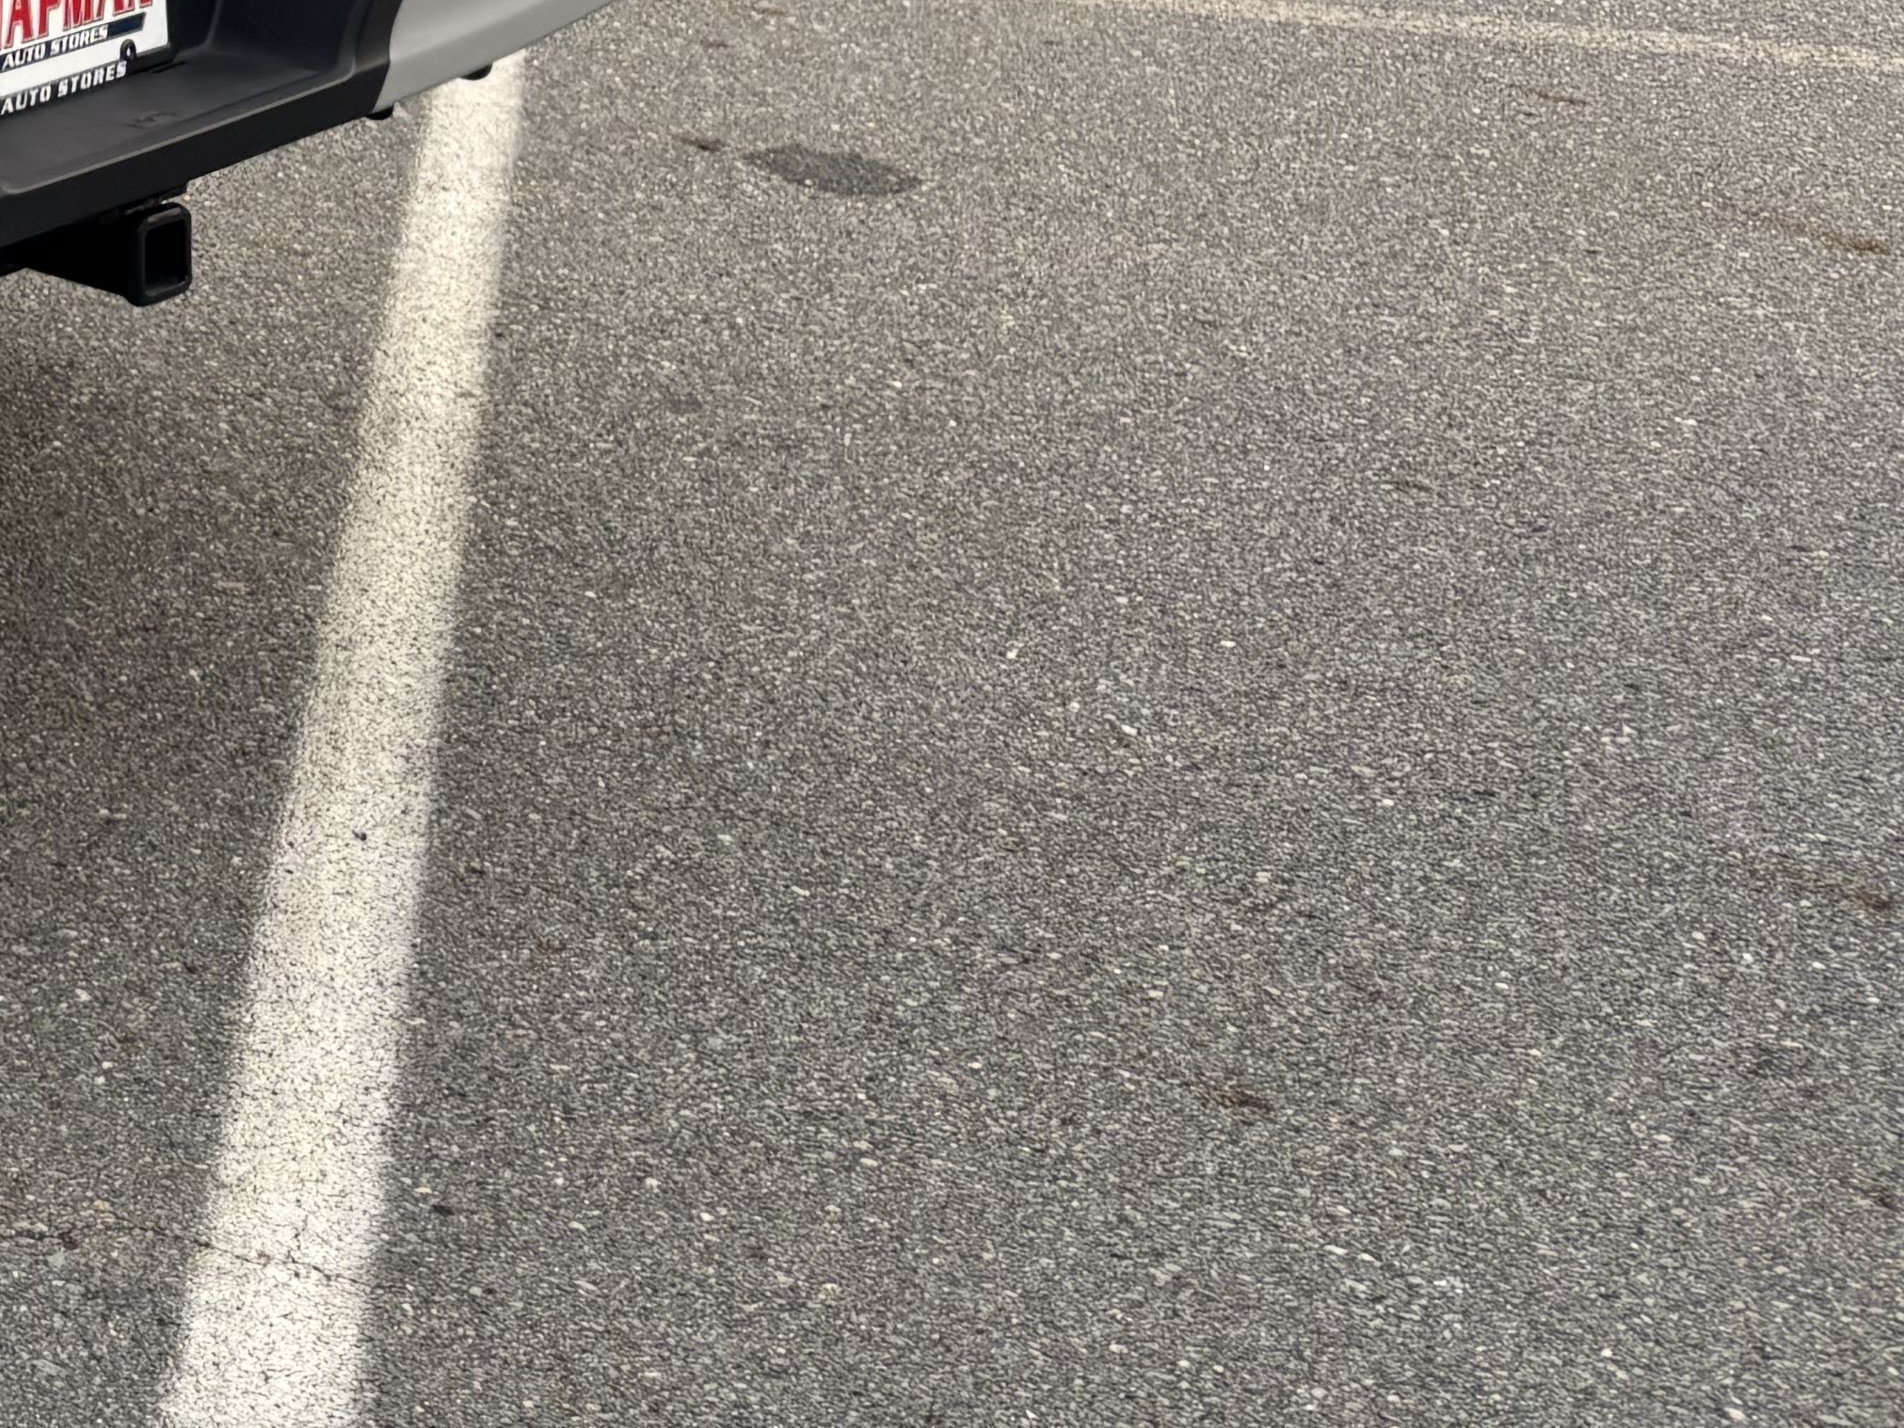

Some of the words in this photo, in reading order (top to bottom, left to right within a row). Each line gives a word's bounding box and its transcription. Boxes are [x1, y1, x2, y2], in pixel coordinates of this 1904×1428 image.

[2, 42, 46, 71] AUTO
[50, 24, 109, 57] STORES
[0, 84, 51, 116] AUTO
[58, 60, 128, 98] STORES
